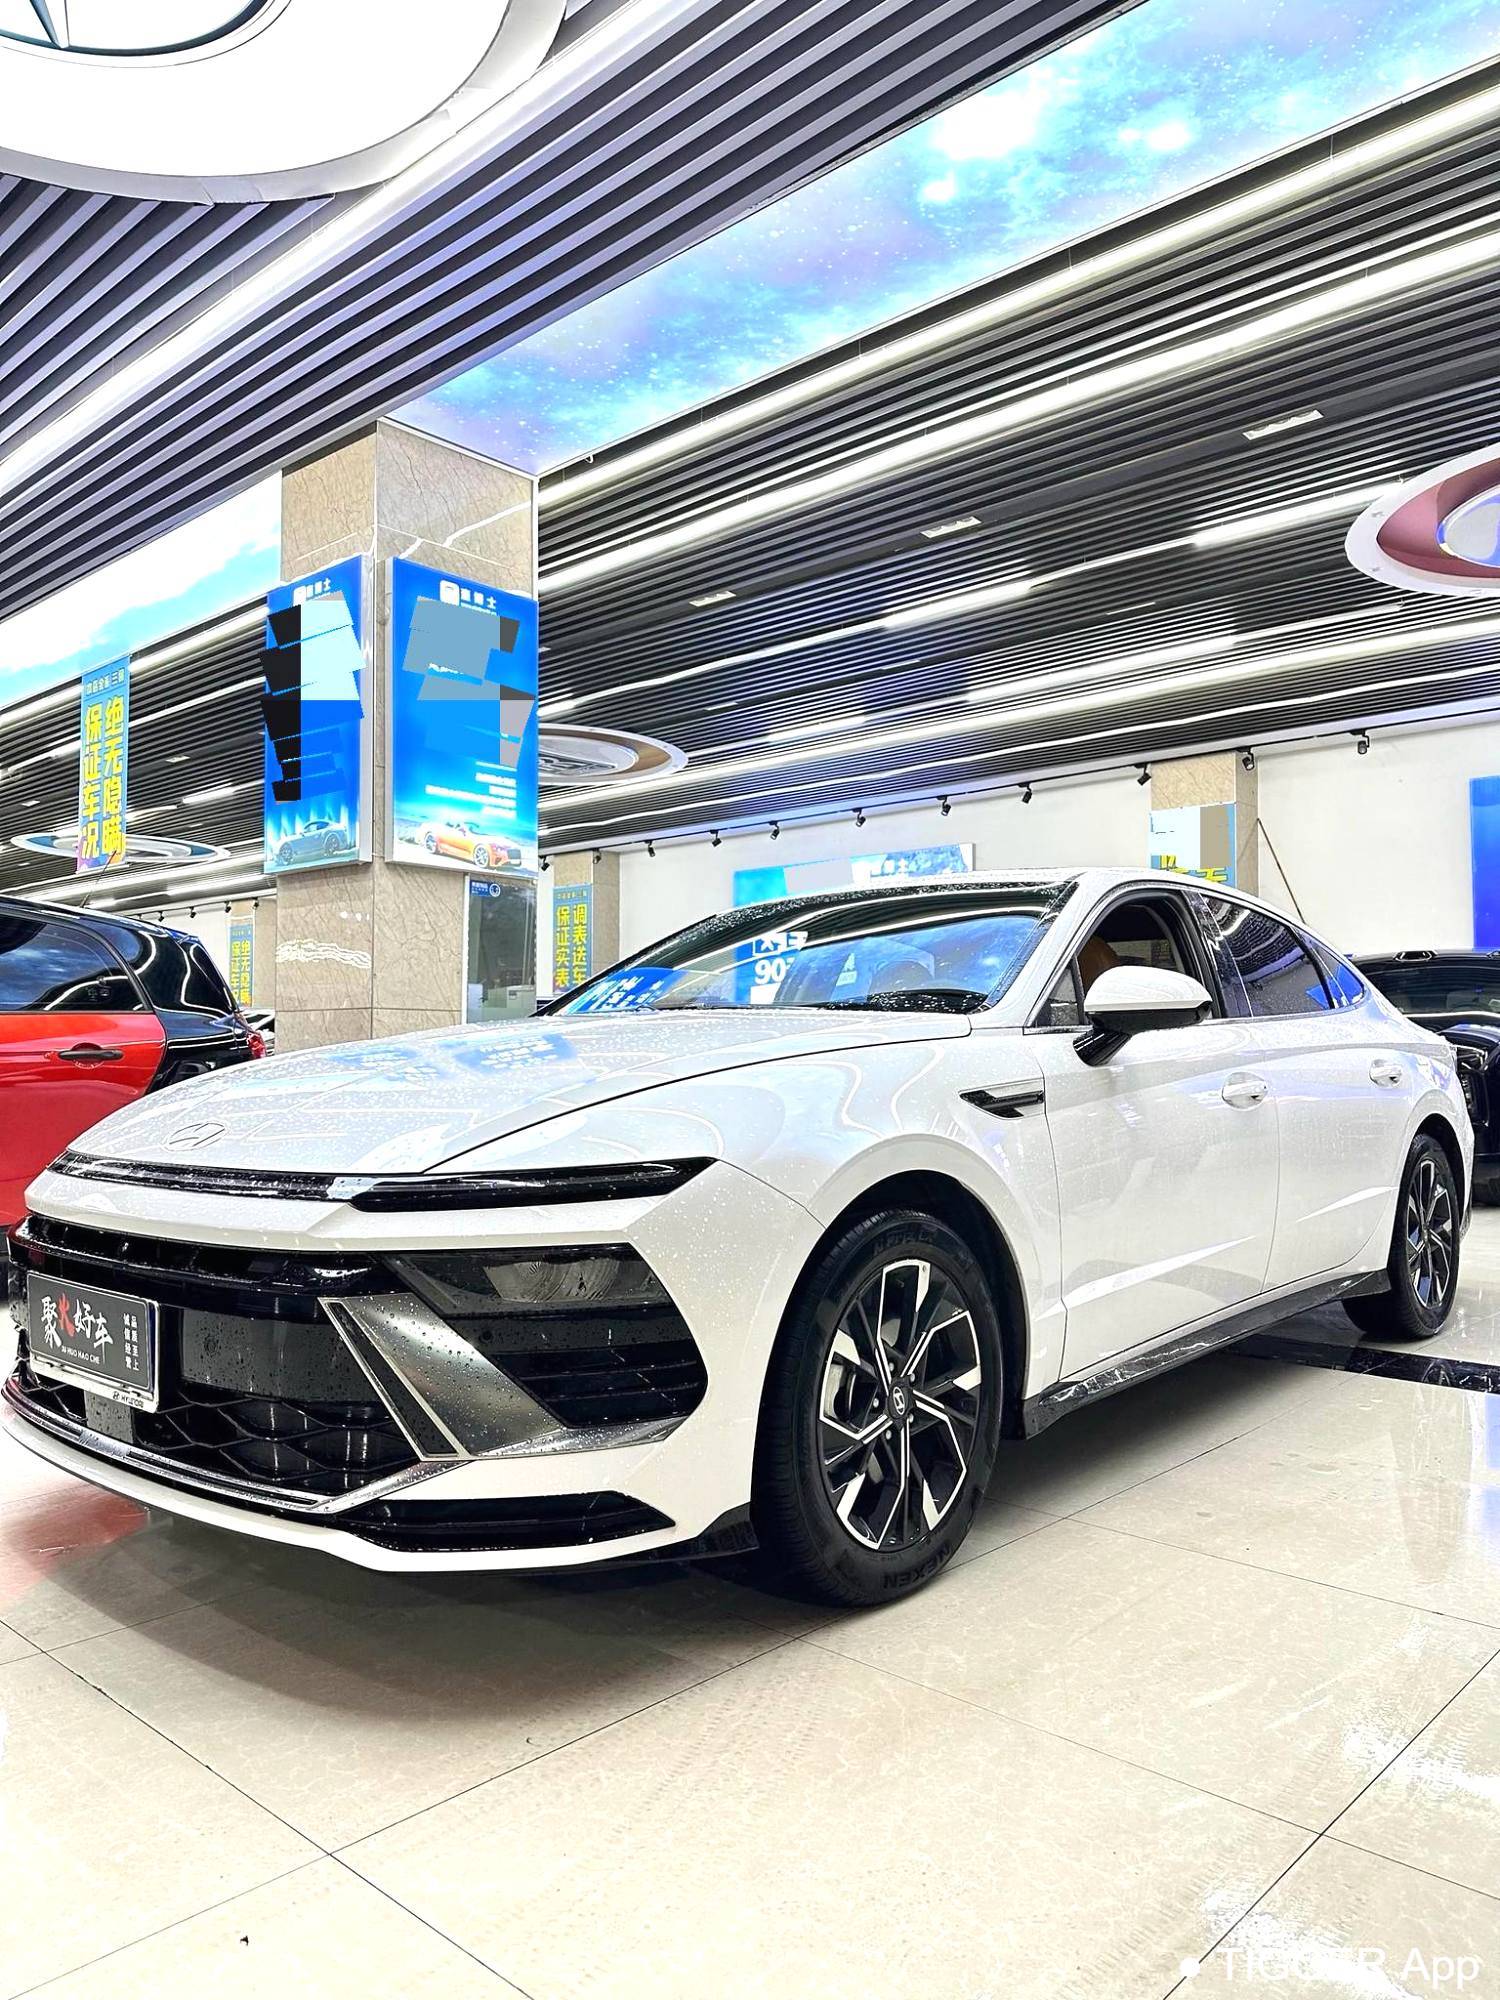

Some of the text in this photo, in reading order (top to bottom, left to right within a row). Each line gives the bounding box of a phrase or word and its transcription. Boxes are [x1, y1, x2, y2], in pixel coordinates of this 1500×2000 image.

[81, 703, 103, 860] 保证车况
[102, 693, 125, 855] 绝无隐瞒
[556, 905, 570, 988] 保证实表
[573, 903, 588, 984] 调表送车
[882, 1543, 952, 1588] NEXEN
